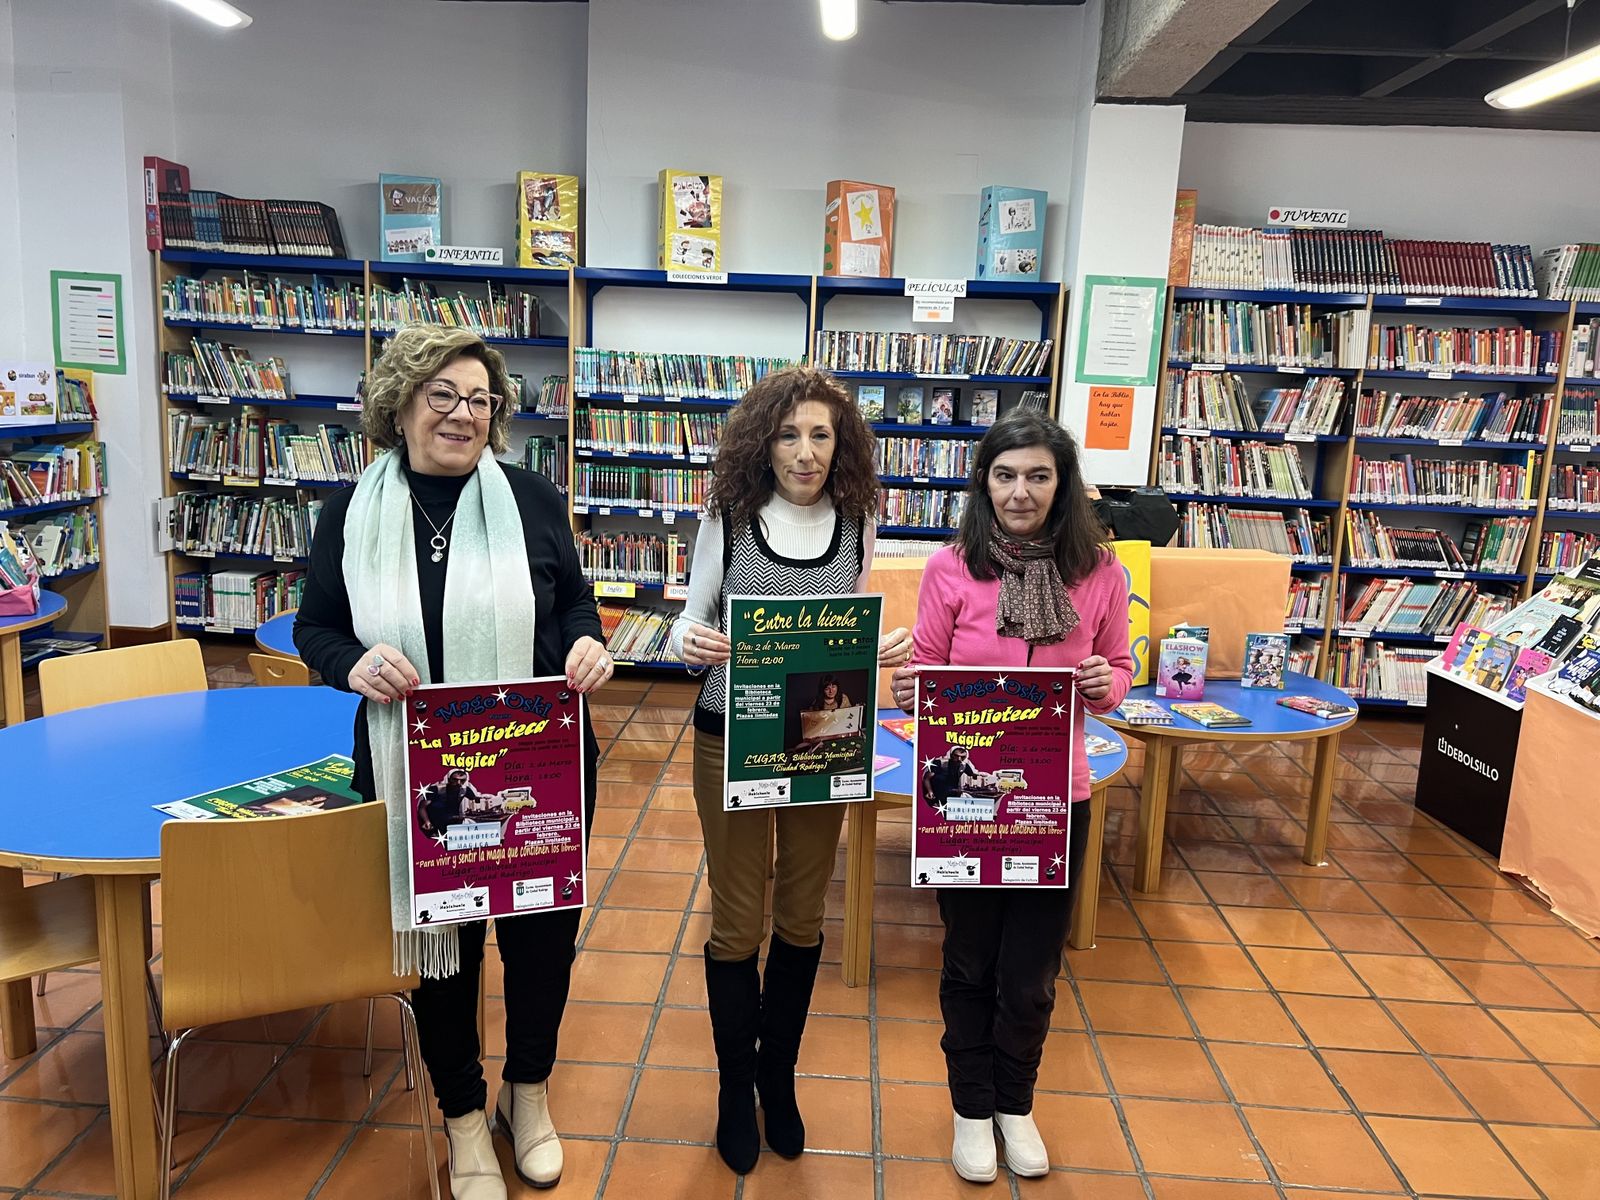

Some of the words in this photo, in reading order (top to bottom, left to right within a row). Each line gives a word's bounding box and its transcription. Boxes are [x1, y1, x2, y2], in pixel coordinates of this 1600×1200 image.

[1281, 209, 1347, 223] JUVENIL
[438, 248, 500, 261] INFANTIL
[907, 281, 965, 294] PELÍCULAS
[797, 605, 813, 628] la
[755, 643, 761, 651] 2
[762, 640, 772, 651] de
[774, 641, 800, 651] Marzo
[736, 656, 759, 665] Hora:
[761, 656, 784, 665] 12:00
[942, 680, 997, 704] Mago
[1003, 679, 1048, 705] Oski
[433, 693, 497, 723] Mago
[503, 692, 553, 719] Oski
[953, 705, 1043, 726] Biblioteca
[448, 719, 550, 748] Biblioteca
[792, 752, 822, 762] Biblioteca
[824, 750, 857, 763] Municipal
[772, 762, 798, 773] (Ciudad
[799, 761, 828, 773] Rodrigo)
[522, 812, 557, 820] Invitaciones
[935, 823, 948, 833] vivir
[949, 825, 954, 837] y
[955, 821, 972, 834] sentir
[972, 821, 979, 834] la
[979, 820, 997, 839] magia
[998, 825, 1009, 839] que
[1038, 825, 1046, 834] los
[436, 854, 452, 866] vivir
[452, 856, 457, 869] y
[458, 850, 478, 865] sentir
[478, 847, 486, 862] la
[486, 845, 507, 864] magia
[507, 847, 519, 864] que
[520, 844, 550, 858] contienen
[551, 843, 560, 853] los
